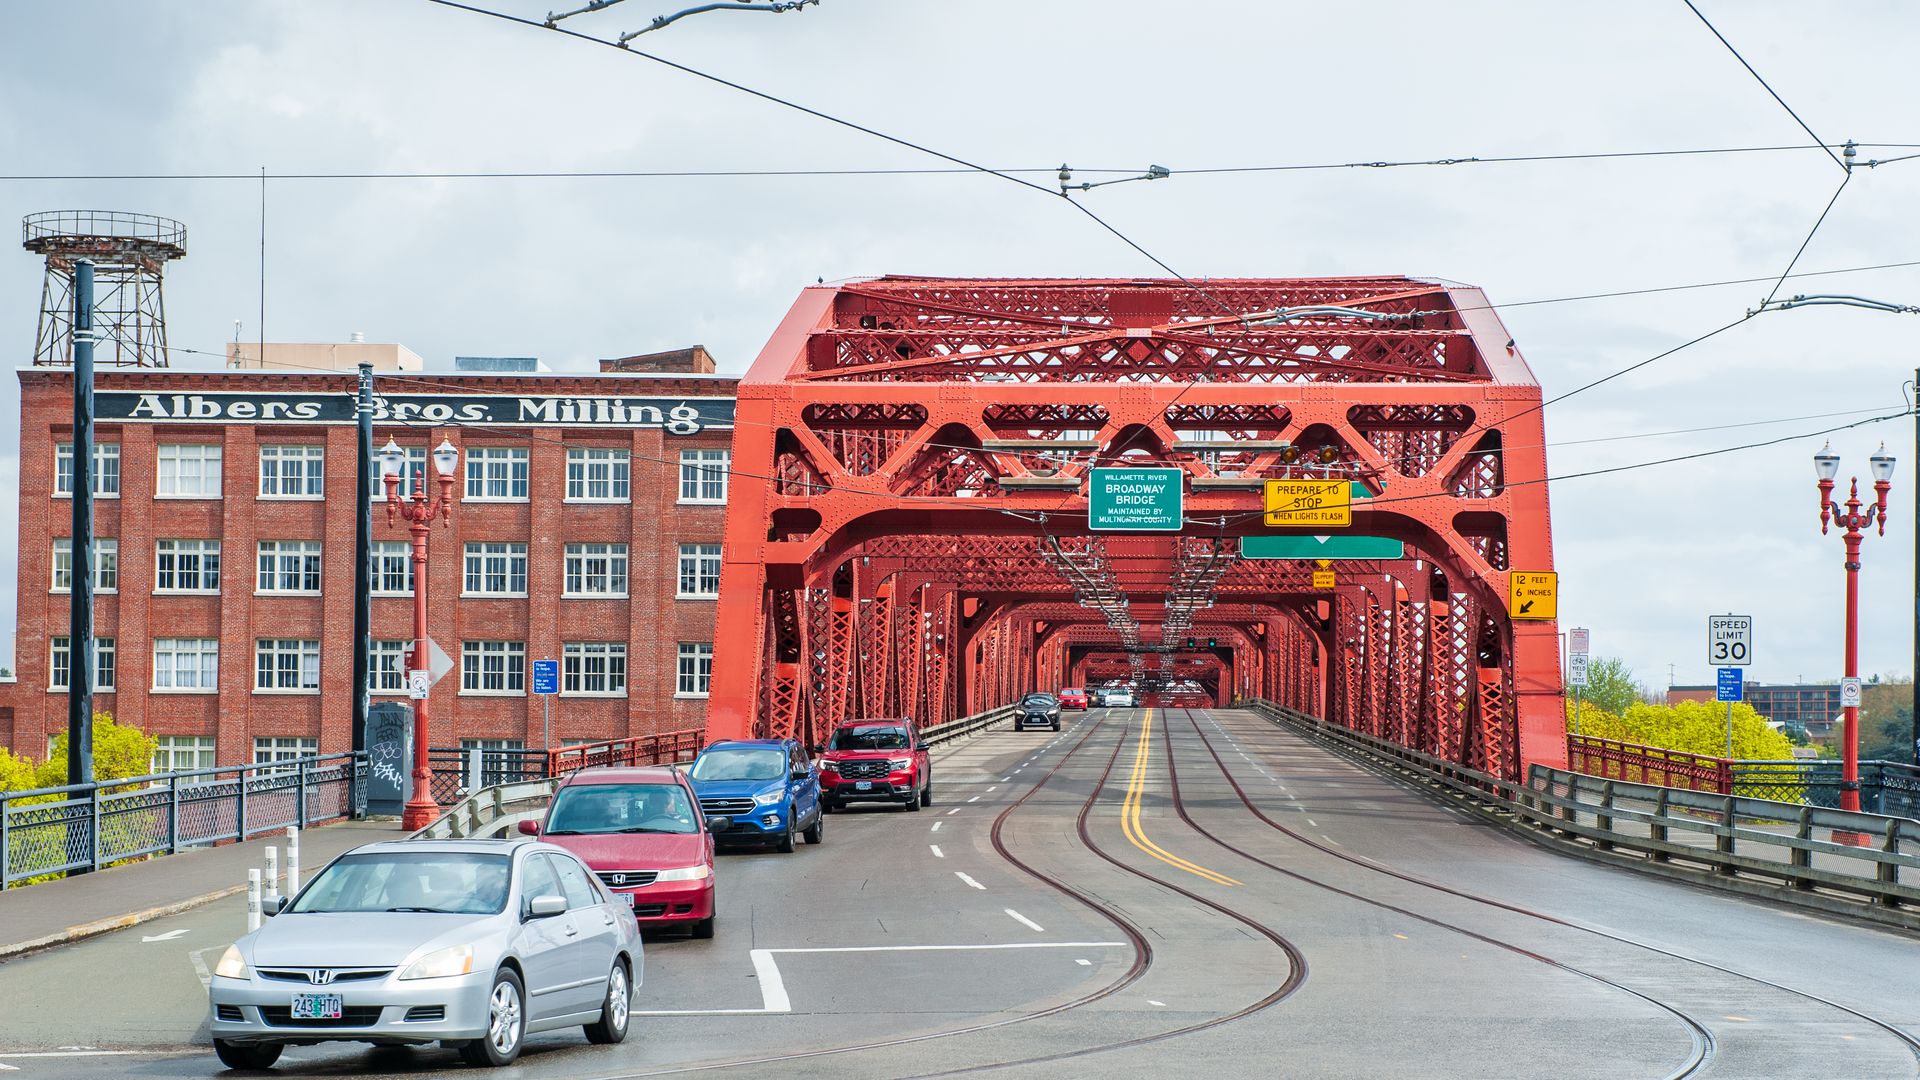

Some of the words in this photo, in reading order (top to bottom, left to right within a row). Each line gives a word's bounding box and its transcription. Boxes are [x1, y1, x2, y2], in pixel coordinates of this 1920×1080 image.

[128, 395, 322, 419] Albers
[518, 398, 700, 435] Milling
[1105, 484, 1166, 494] BROADWAY
[1277, 485, 1322, 495] PREPARE
[1327, 485, 1339, 495] TO
[1115, 495, 1156, 505] BRIDGE
[1293, 497, 1323, 508] STOP
[1273, 512, 1293, 520] WHEN
[1295, 512, 1319, 520] LIGHTS
[1321, 512, 1343, 520] FLASH
[1516, 575, 1526, 585] 12
[1516, 588, 1522, 597] 6
[1713, 620, 1748, 629] SPEED
[1716, 631, 1744, 640] LIMIT
[1714, 642, 1746, 660] 30
[294, 998, 314, 1012] 243
